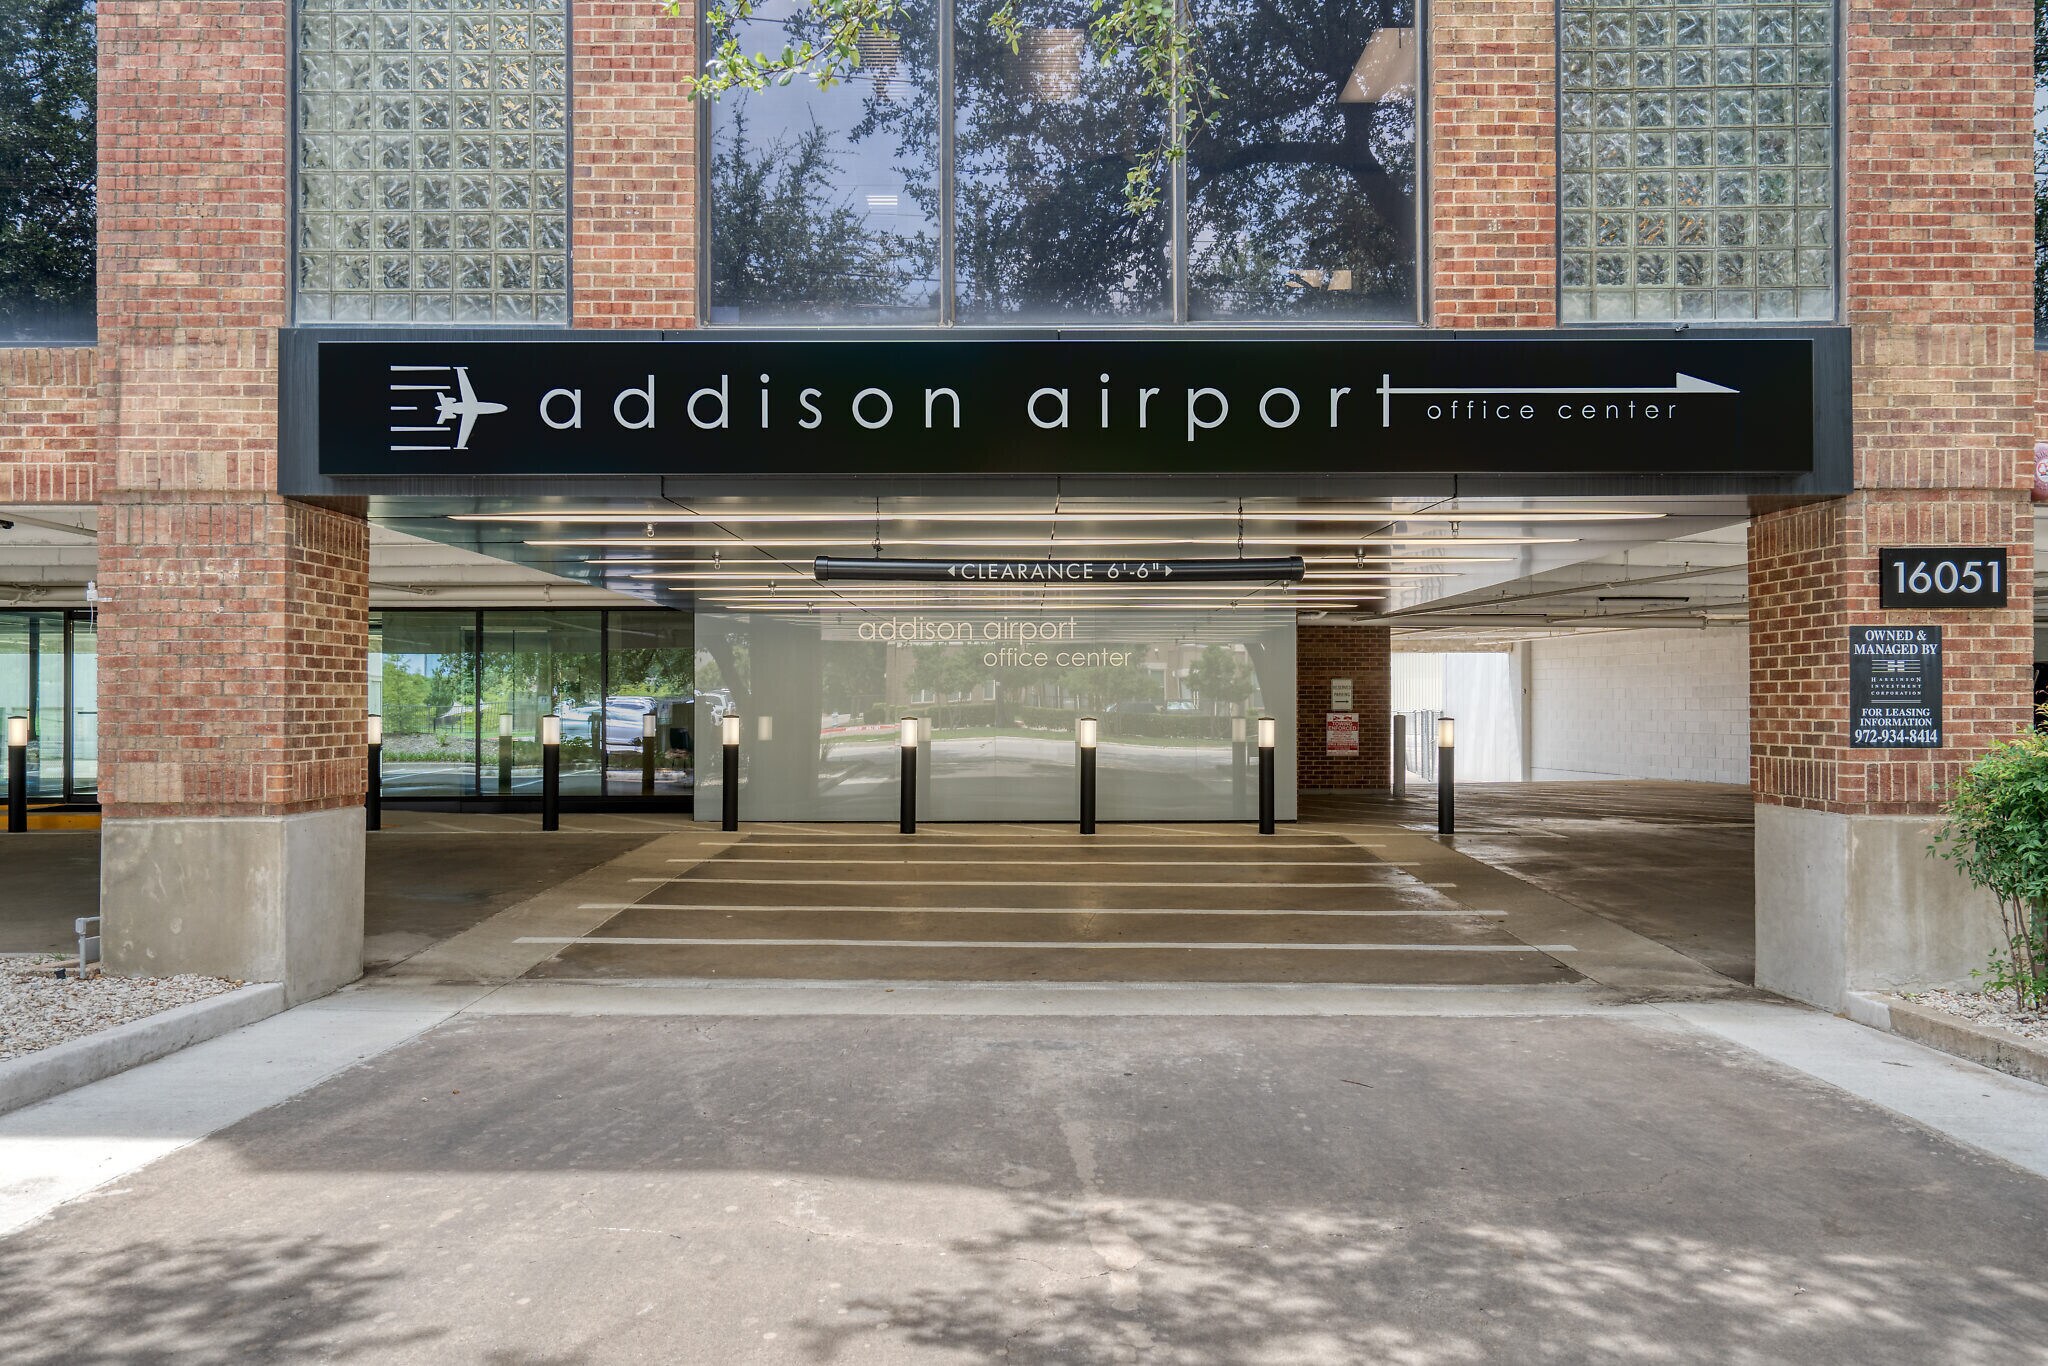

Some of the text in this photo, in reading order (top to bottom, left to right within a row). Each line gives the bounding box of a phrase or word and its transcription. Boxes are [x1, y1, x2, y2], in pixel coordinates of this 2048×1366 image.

[540, 374, 1390, 442] addison airport
[1428, 400, 1677, 420] office center
[961, 562, 1160, 580] CLEARANCE 6'-6"
[1893, 561, 2001, 594] 16051
[858, 616, 1077, 646] addison airport
[1865, 630, 1927, 642] OWNED &
[983, 648, 1132, 667] office center
[1854, 643, 1938, 655] MANAGED BY
[1862, 708, 1931, 717] FOR LEASING
[1860, 717, 1933, 727] INFORMATION
[1854, 729, 1938, 743] 972-934-8414
